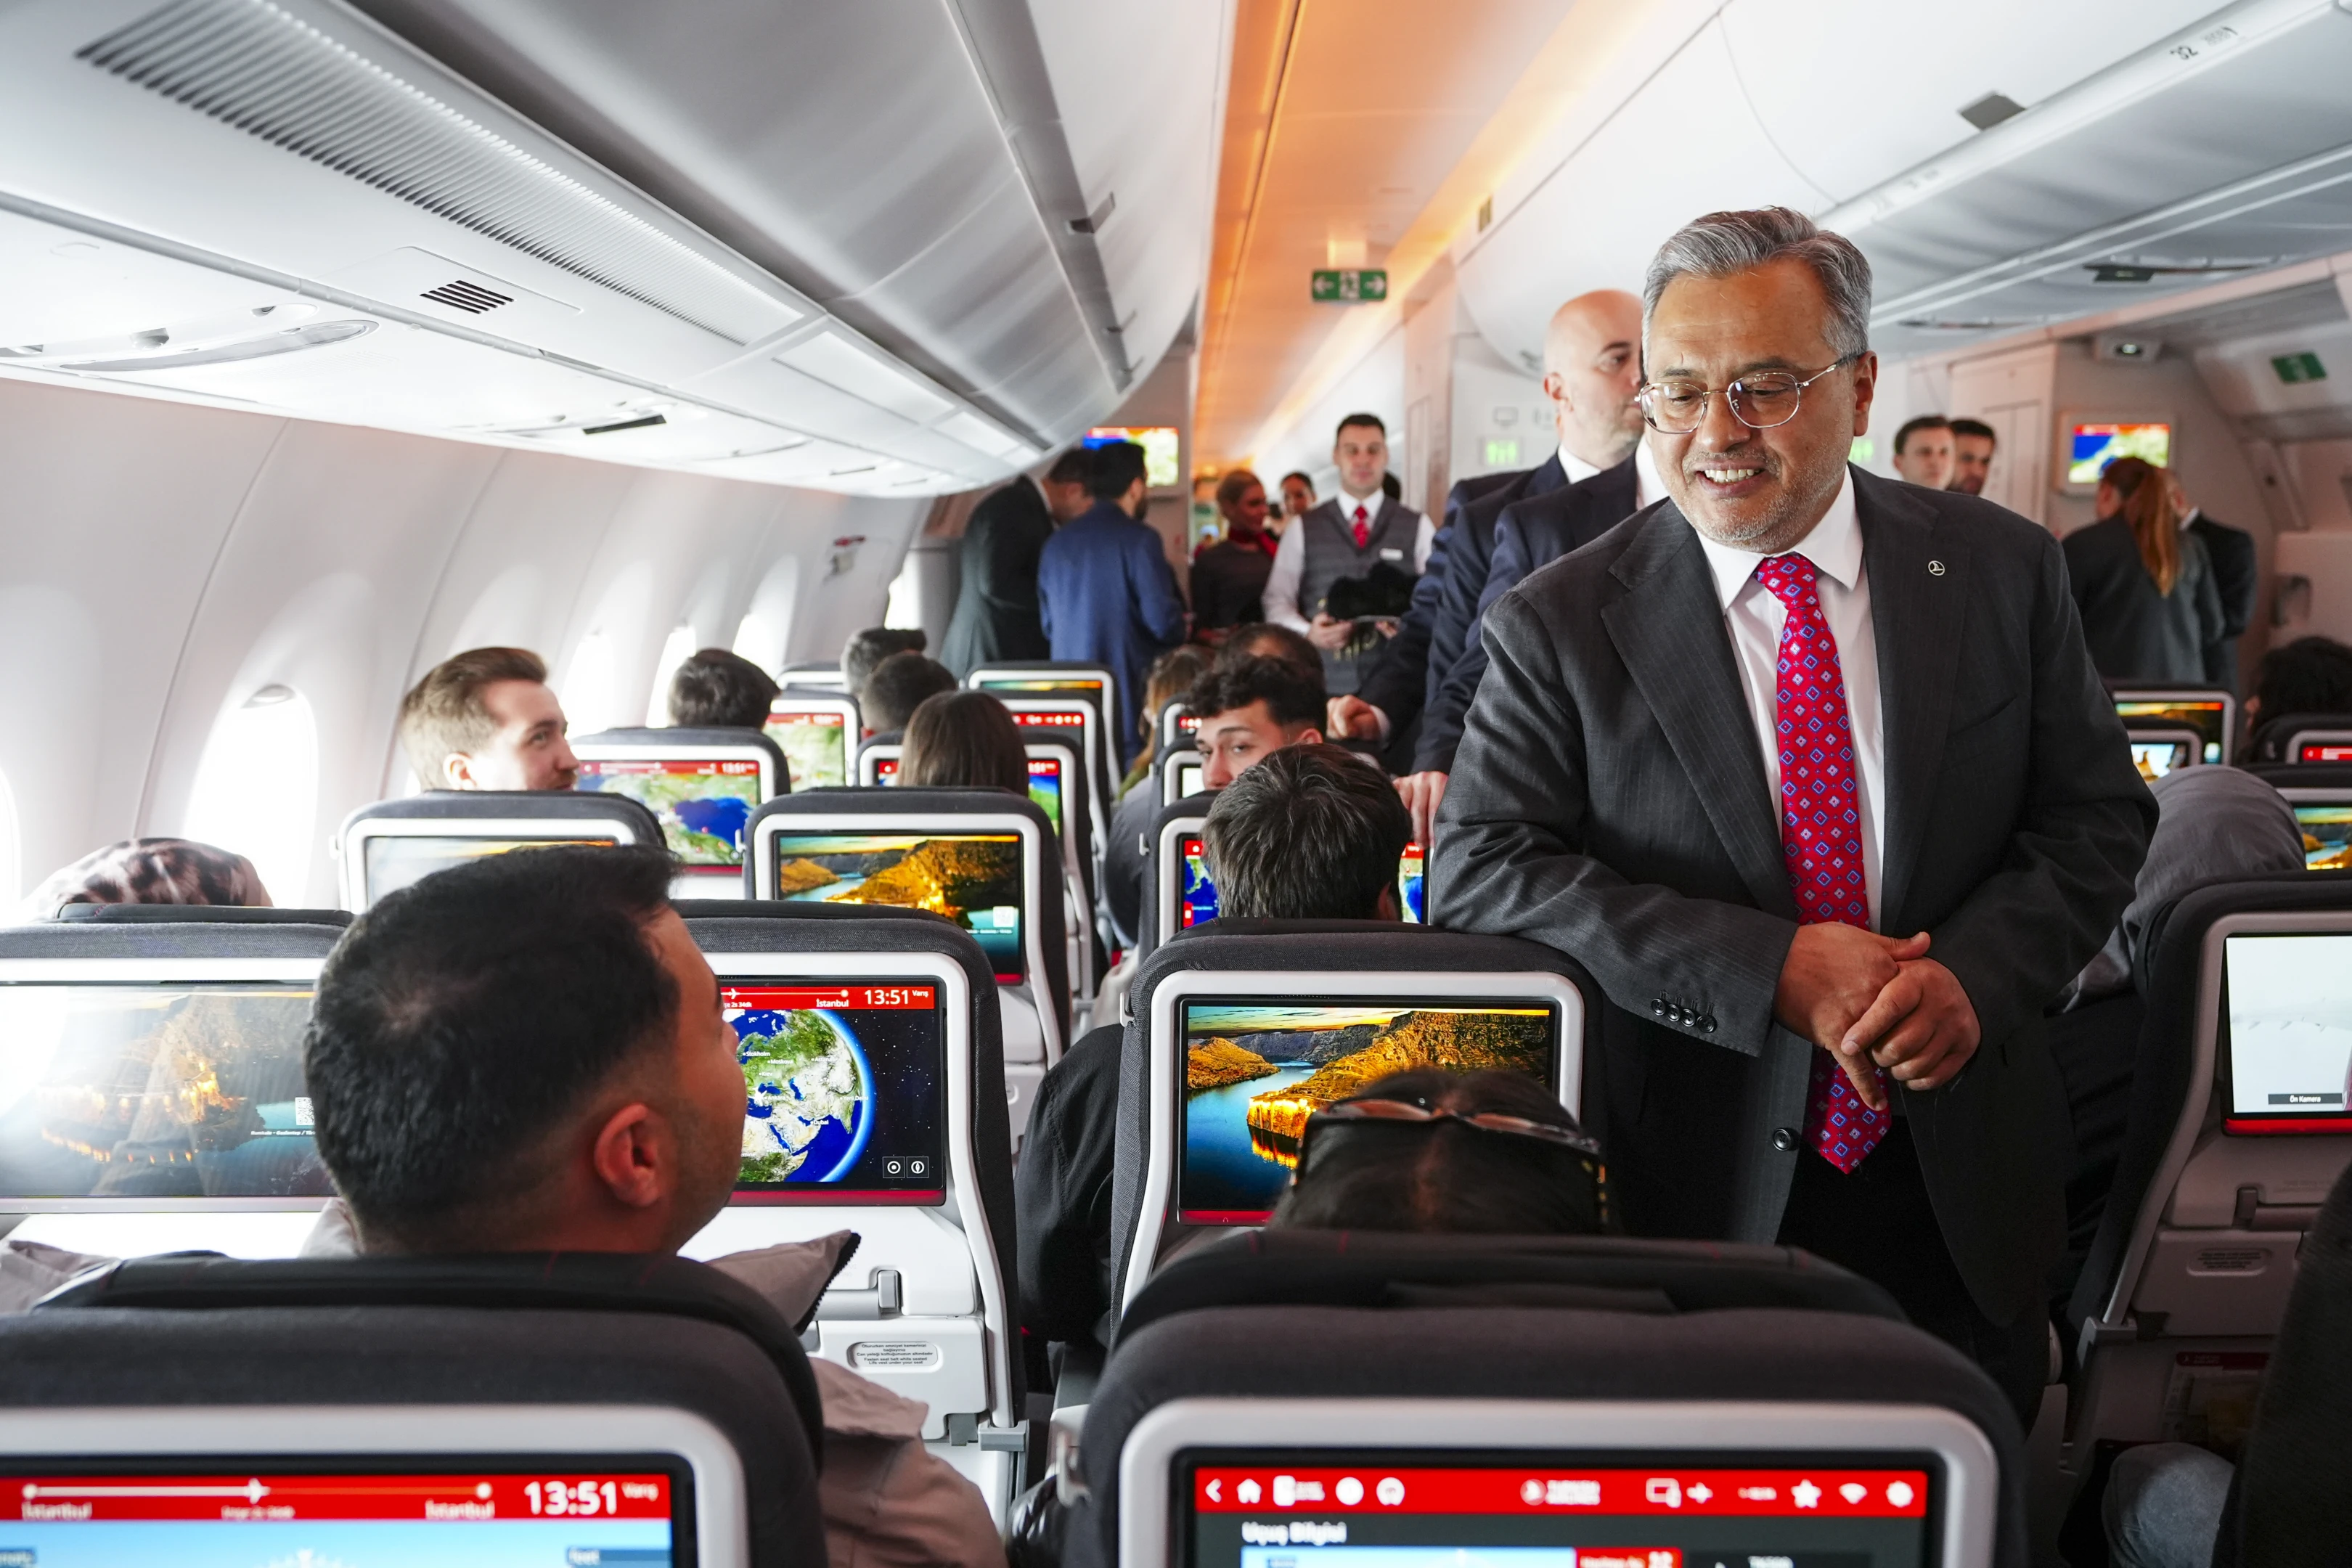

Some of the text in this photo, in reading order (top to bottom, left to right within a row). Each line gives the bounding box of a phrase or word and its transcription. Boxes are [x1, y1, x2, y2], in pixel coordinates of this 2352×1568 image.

[816, 998, 849, 1008] İstanbul
[865, 989, 908, 1005] 13:51
[524, 1480, 617, 1515] 13:51
